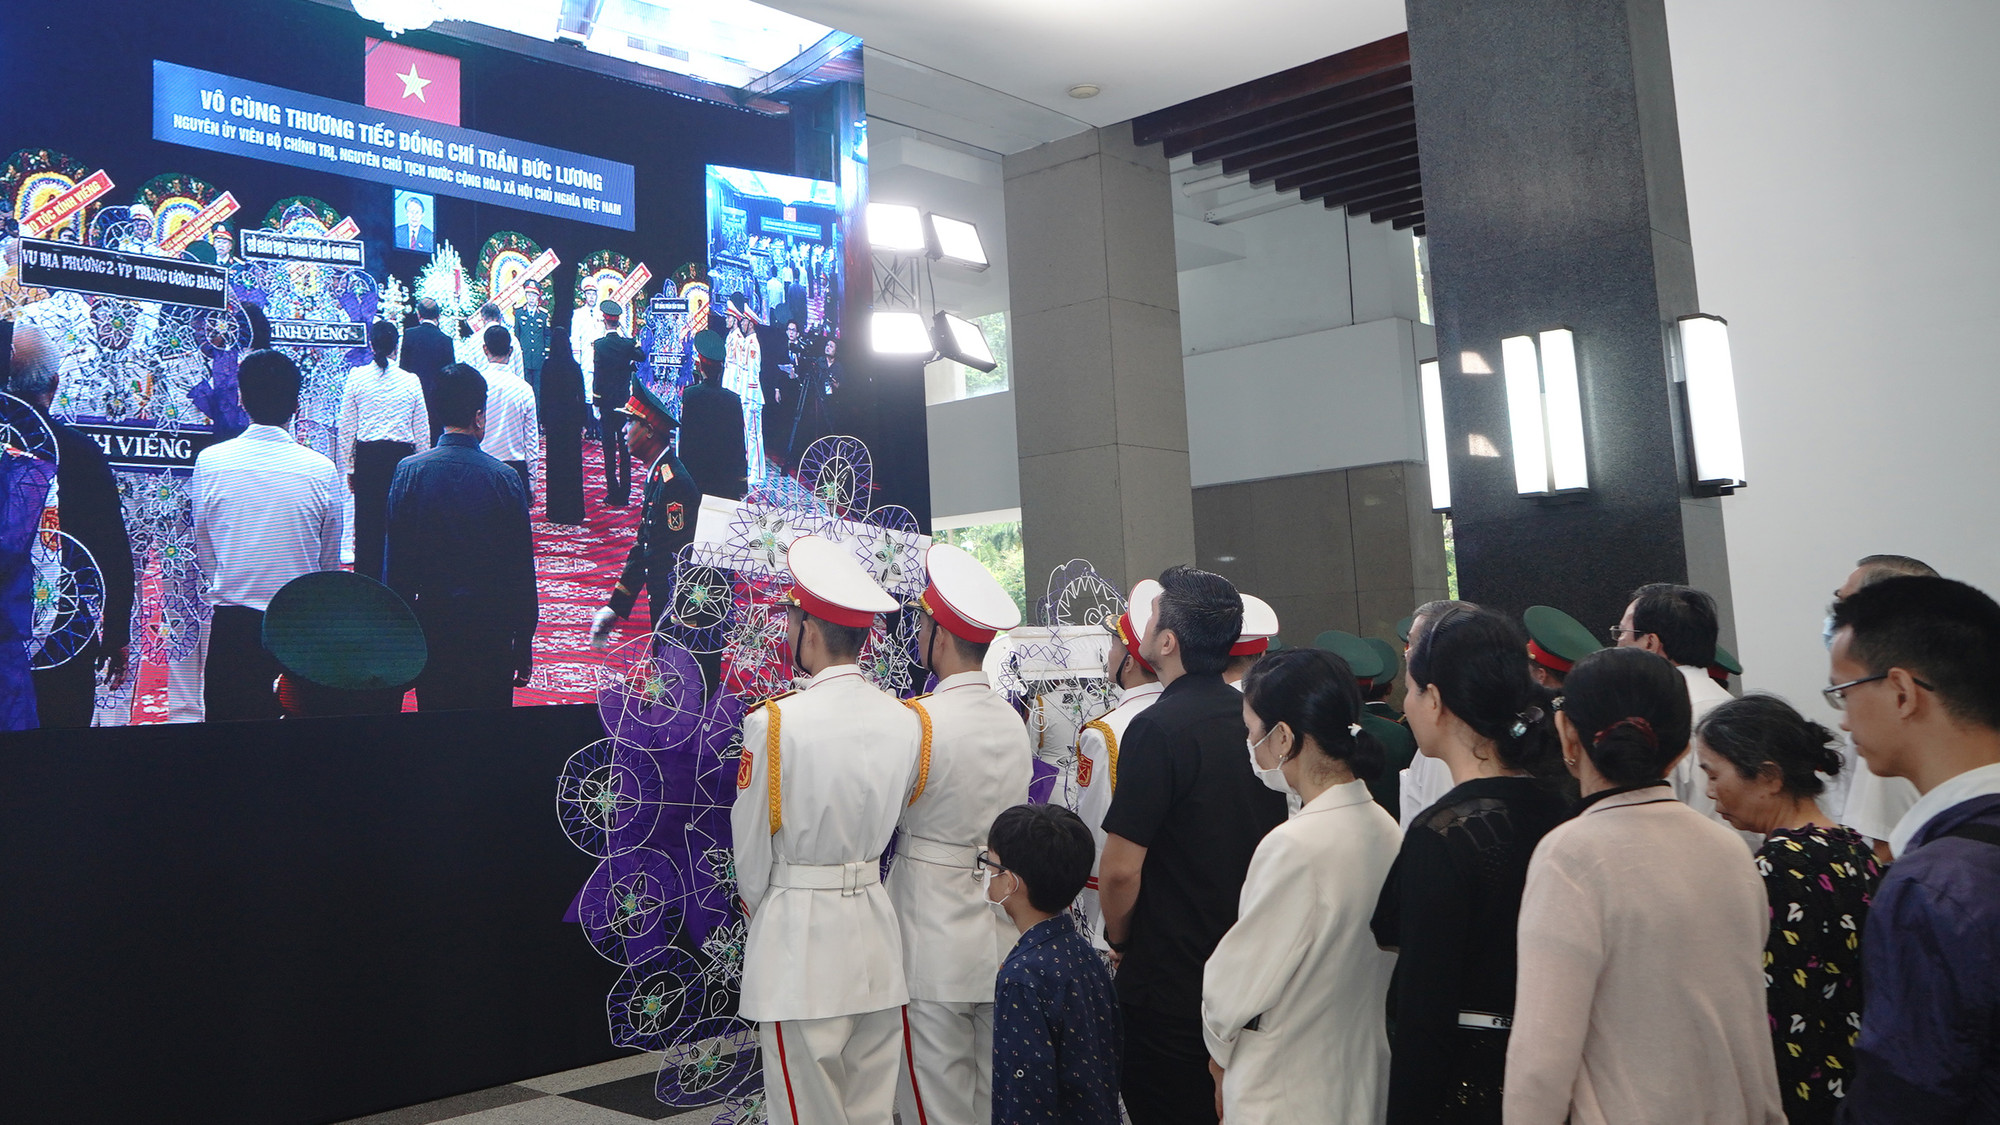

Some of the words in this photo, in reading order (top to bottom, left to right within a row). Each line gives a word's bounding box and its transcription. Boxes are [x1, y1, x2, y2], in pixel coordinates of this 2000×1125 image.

[173, 113, 220, 137] NGUYÊN
[221, 120, 237, 140] ỦY
[238, 126, 264, 146] VIÊN
[266, 132, 282, 151] BỘ
[283, 136, 317, 156] CHÍNH
[339, 147, 381, 169] NGUYÊN
[382, 154, 402, 173] CHỦ
[404, 160, 426, 177] TỊCH
[427, 165, 454, 183] NƯỚC
[455, 170, 482, 190] CỘNG
[482, 176, 502, 193] HÒA
[503, 180, 516, 195] XÃ
[518, 183, 533, 200] HỘI
[534, 186, 553, 203] CHỦ
[554, 191, 581, 208] NGHĨA
[582, 196, 601, 213] VIỆT
[602, 201, 622, 216] NAM
[200, 88, 226, 113] VÔ
[230, 95, 281, 125] CÙNG
[285, 106, 355, 141] THƯƠNG
[358, 121, 395, 149] TIẾC
[398, 129, 444, 159] ĐỒNG
[447, 142, 475, 165] CHÍ
[477, 147, 519, 175] TRẦN
[521, 157, 552, 181] ĐỨC
[555, 165, 603, 192] LƯƠNG
[134, 265, 168, 284] TRUNG
[116, 432, 192, 459] VIẾNG
